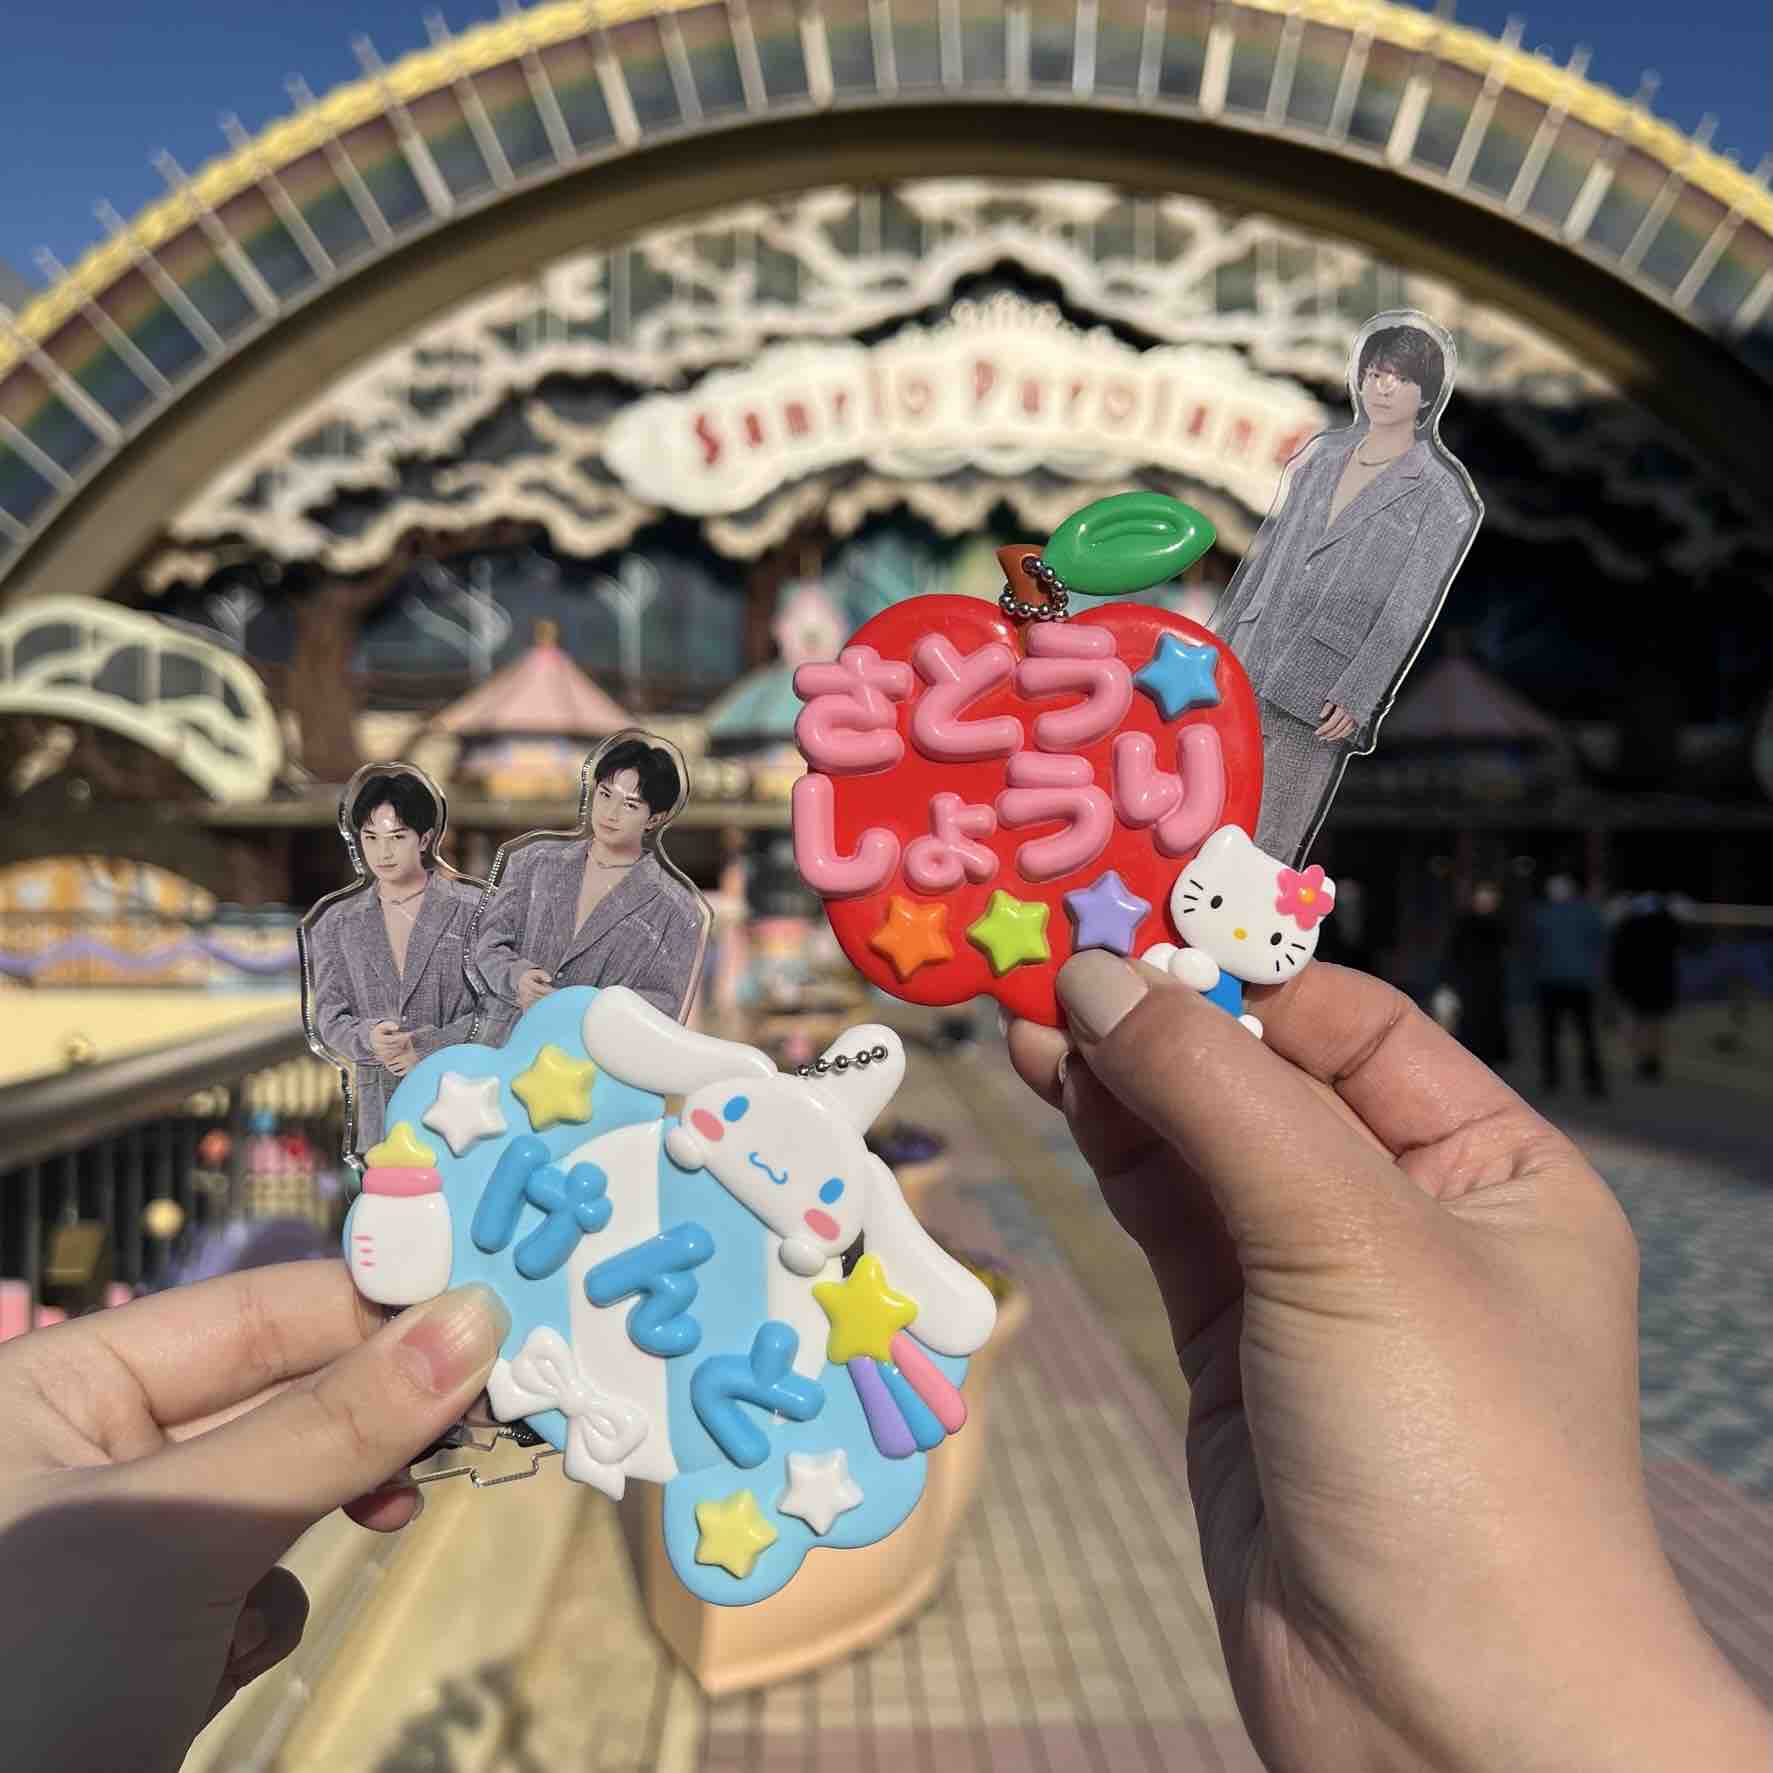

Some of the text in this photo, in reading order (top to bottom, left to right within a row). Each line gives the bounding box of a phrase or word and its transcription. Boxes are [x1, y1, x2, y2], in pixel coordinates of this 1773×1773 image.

[792, 623, 1134, 775] さとう
[792, 724, 1227, 898] しょうり
[470, 1134, 826, 1469] けんと
